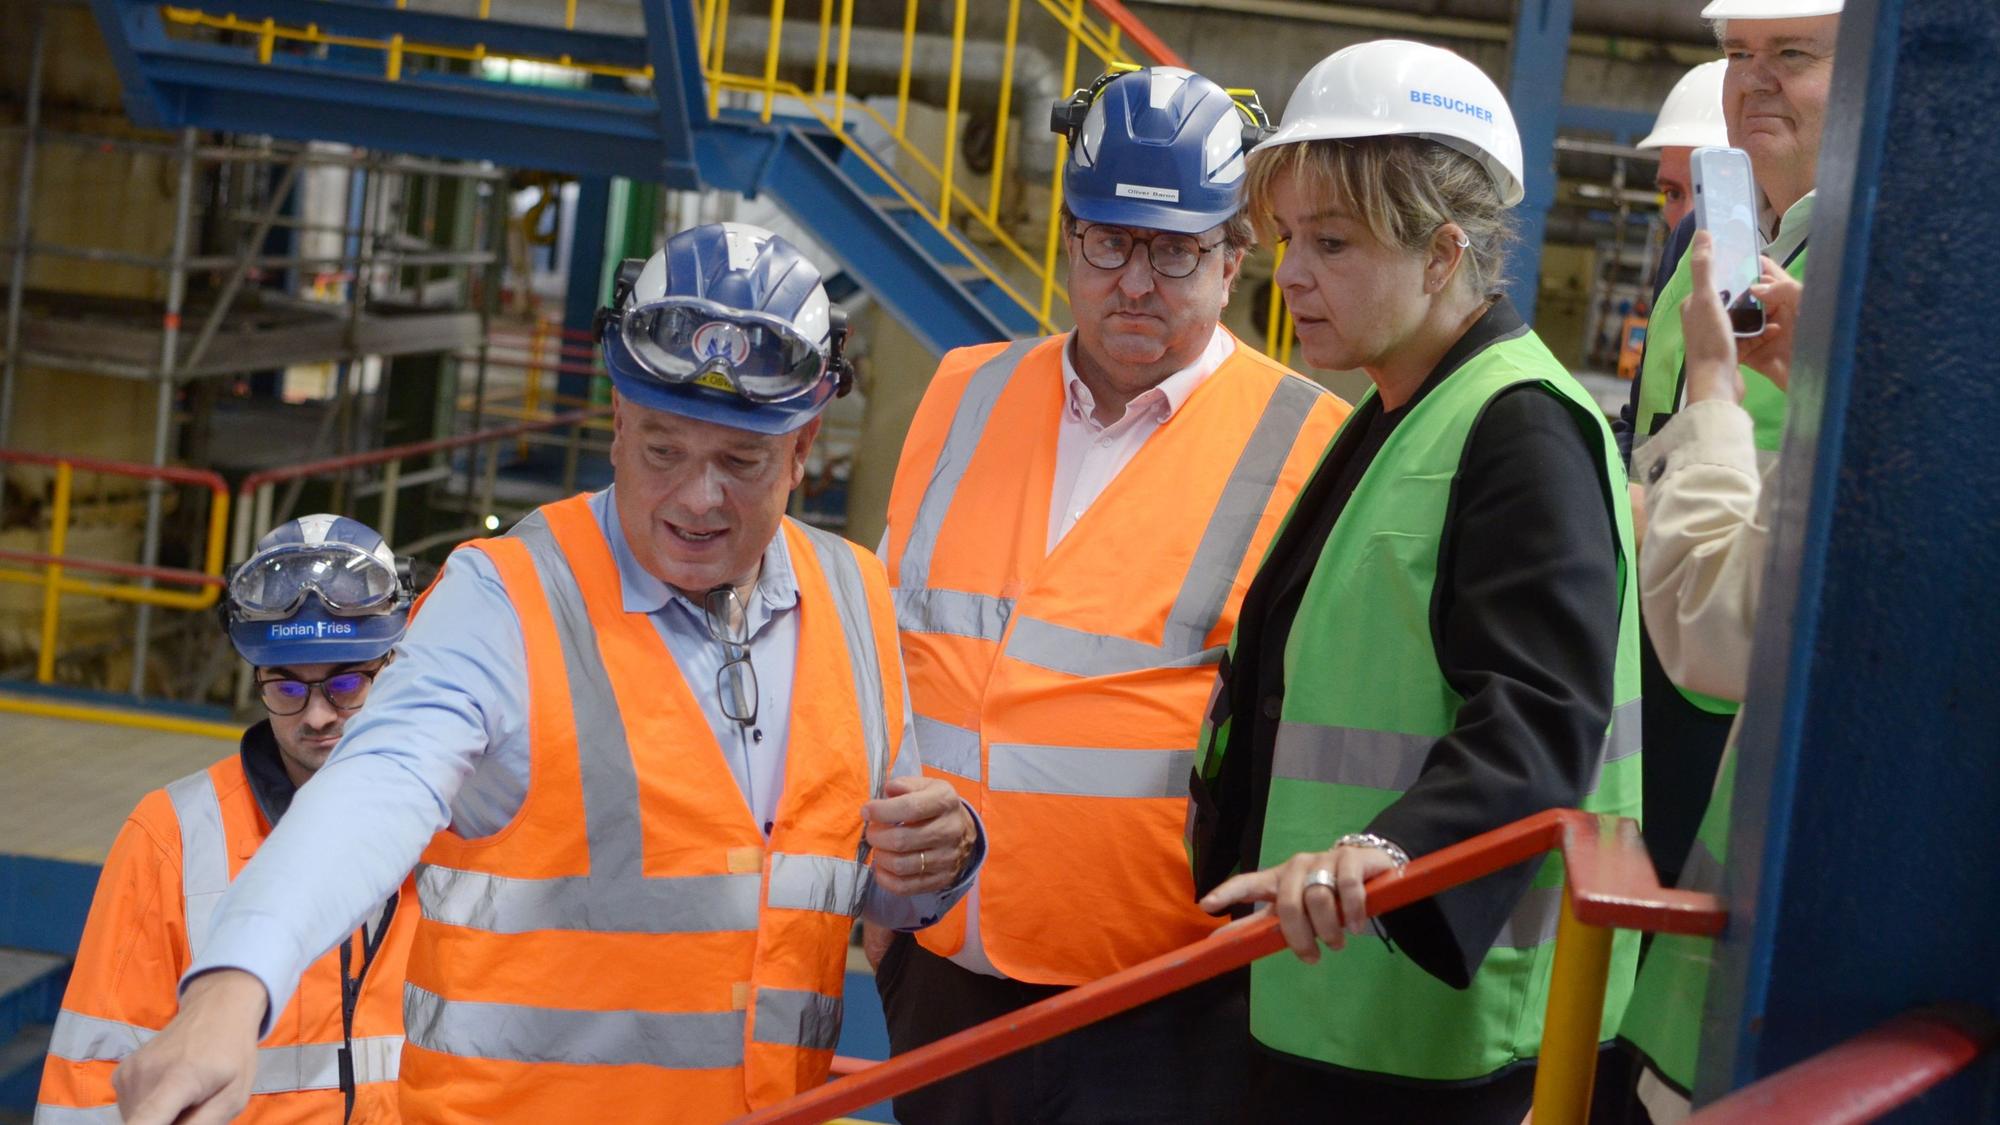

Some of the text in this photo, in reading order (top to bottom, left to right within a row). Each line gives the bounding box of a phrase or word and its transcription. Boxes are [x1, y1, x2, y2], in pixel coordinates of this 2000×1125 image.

[1410, 90, 1493, 122] BESUCHER
[271, 621, 351, 637] Florian Fries
